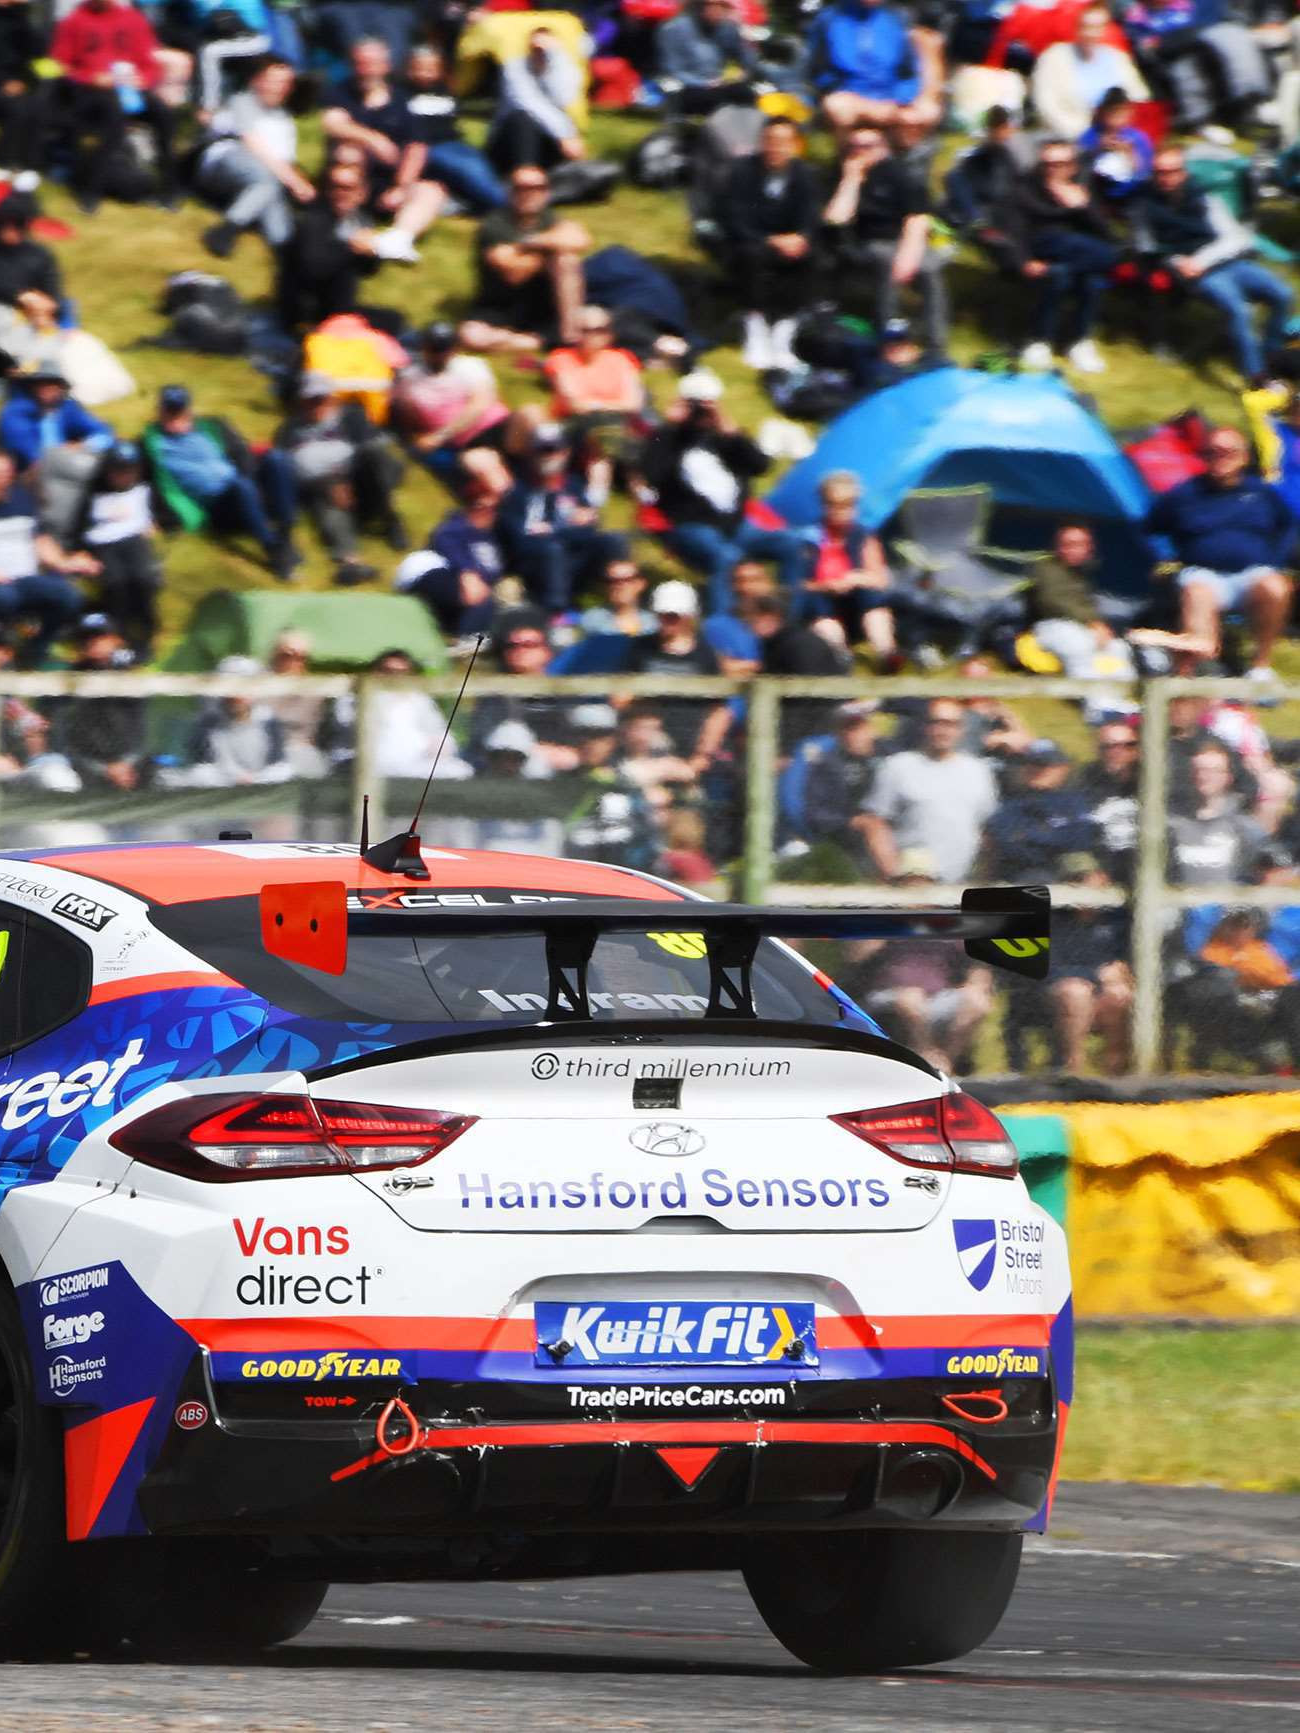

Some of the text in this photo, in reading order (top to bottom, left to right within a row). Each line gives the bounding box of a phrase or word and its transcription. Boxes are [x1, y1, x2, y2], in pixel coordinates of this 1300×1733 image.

[57, 893, 117, 925] HRX
[565, 1058, 792, 1078] third millennium
[458, 1169, 890, 1209] Hansford Sensors
[233, 1218, 350, 1257] Vans
[1000, 1220, 1045, 1243] Bristol
[1004, 1246, 1043, 1270] Street
[60, 1268, 109, 1296] SCORPION
[1006, 1274, 1044, 1295] Motors
[61, 1356, 107, 1375] Hansford
[241, 1352, 402, 1381] GOODYEAR
[947, 1348, 1039, 1378] GOODYEAR
[61, 1369, 103, 1386] Sensors
[303, 1396, 338, 1408] TOW
[567, 1386, 786, 1408] TradePriceCars.com
[179, 1408, 203, 1422] ABS
